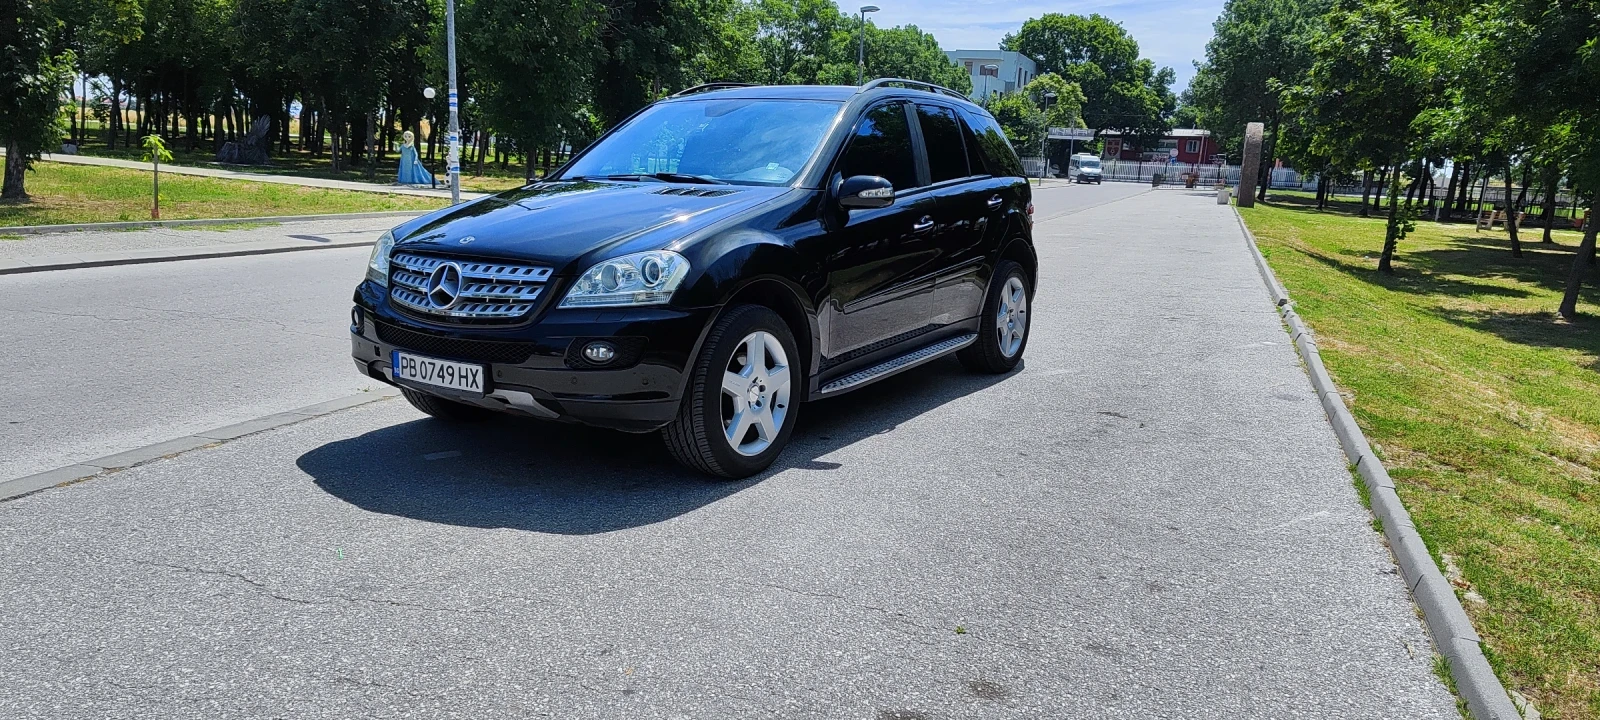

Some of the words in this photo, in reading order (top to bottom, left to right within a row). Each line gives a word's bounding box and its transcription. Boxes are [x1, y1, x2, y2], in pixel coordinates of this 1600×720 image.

[401, 356, 417, 378] PB
[420, 360, 455, 385] 0749
[458, 366, 480, 389] HX
